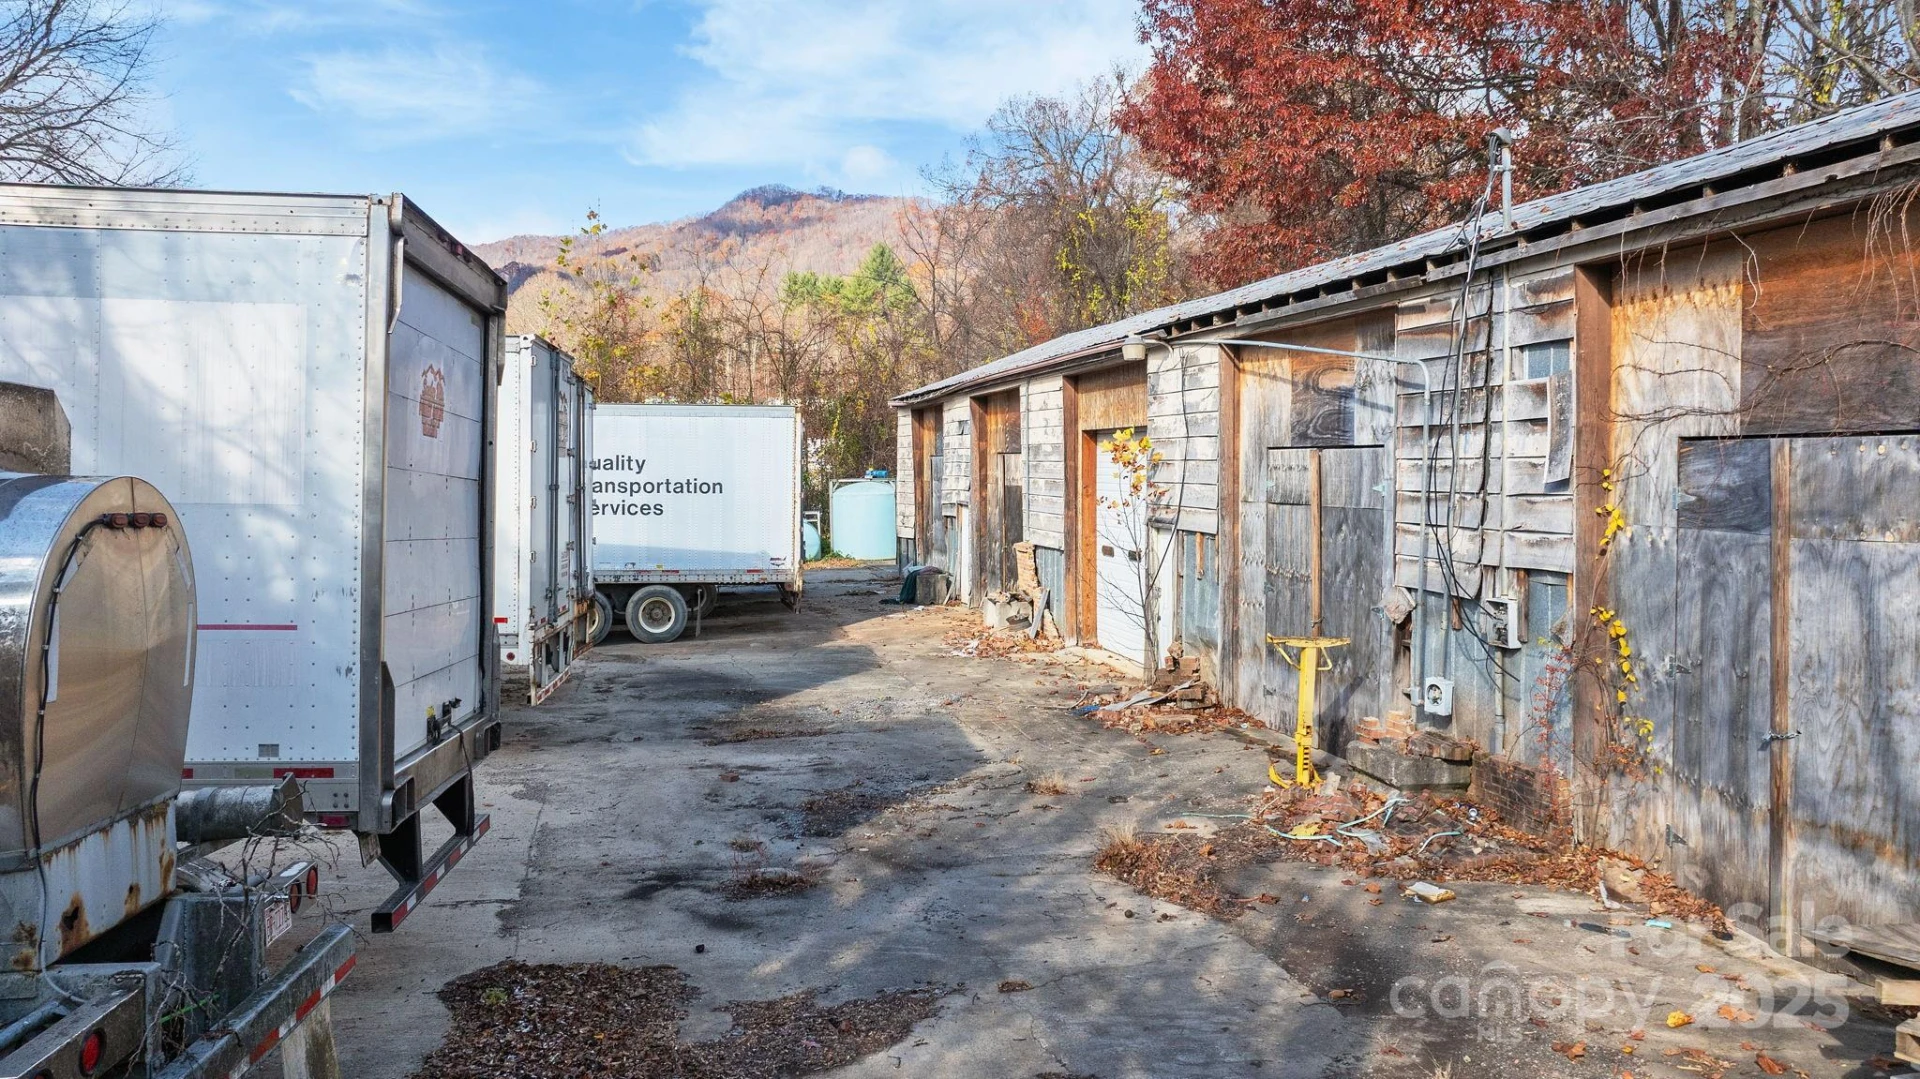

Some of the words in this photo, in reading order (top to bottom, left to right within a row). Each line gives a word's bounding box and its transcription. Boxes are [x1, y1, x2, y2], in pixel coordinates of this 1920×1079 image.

[591, 455, 646, 475] uality
[592, 478, 723, 497] ansportation
[592, 500, 664, 516] ervices
